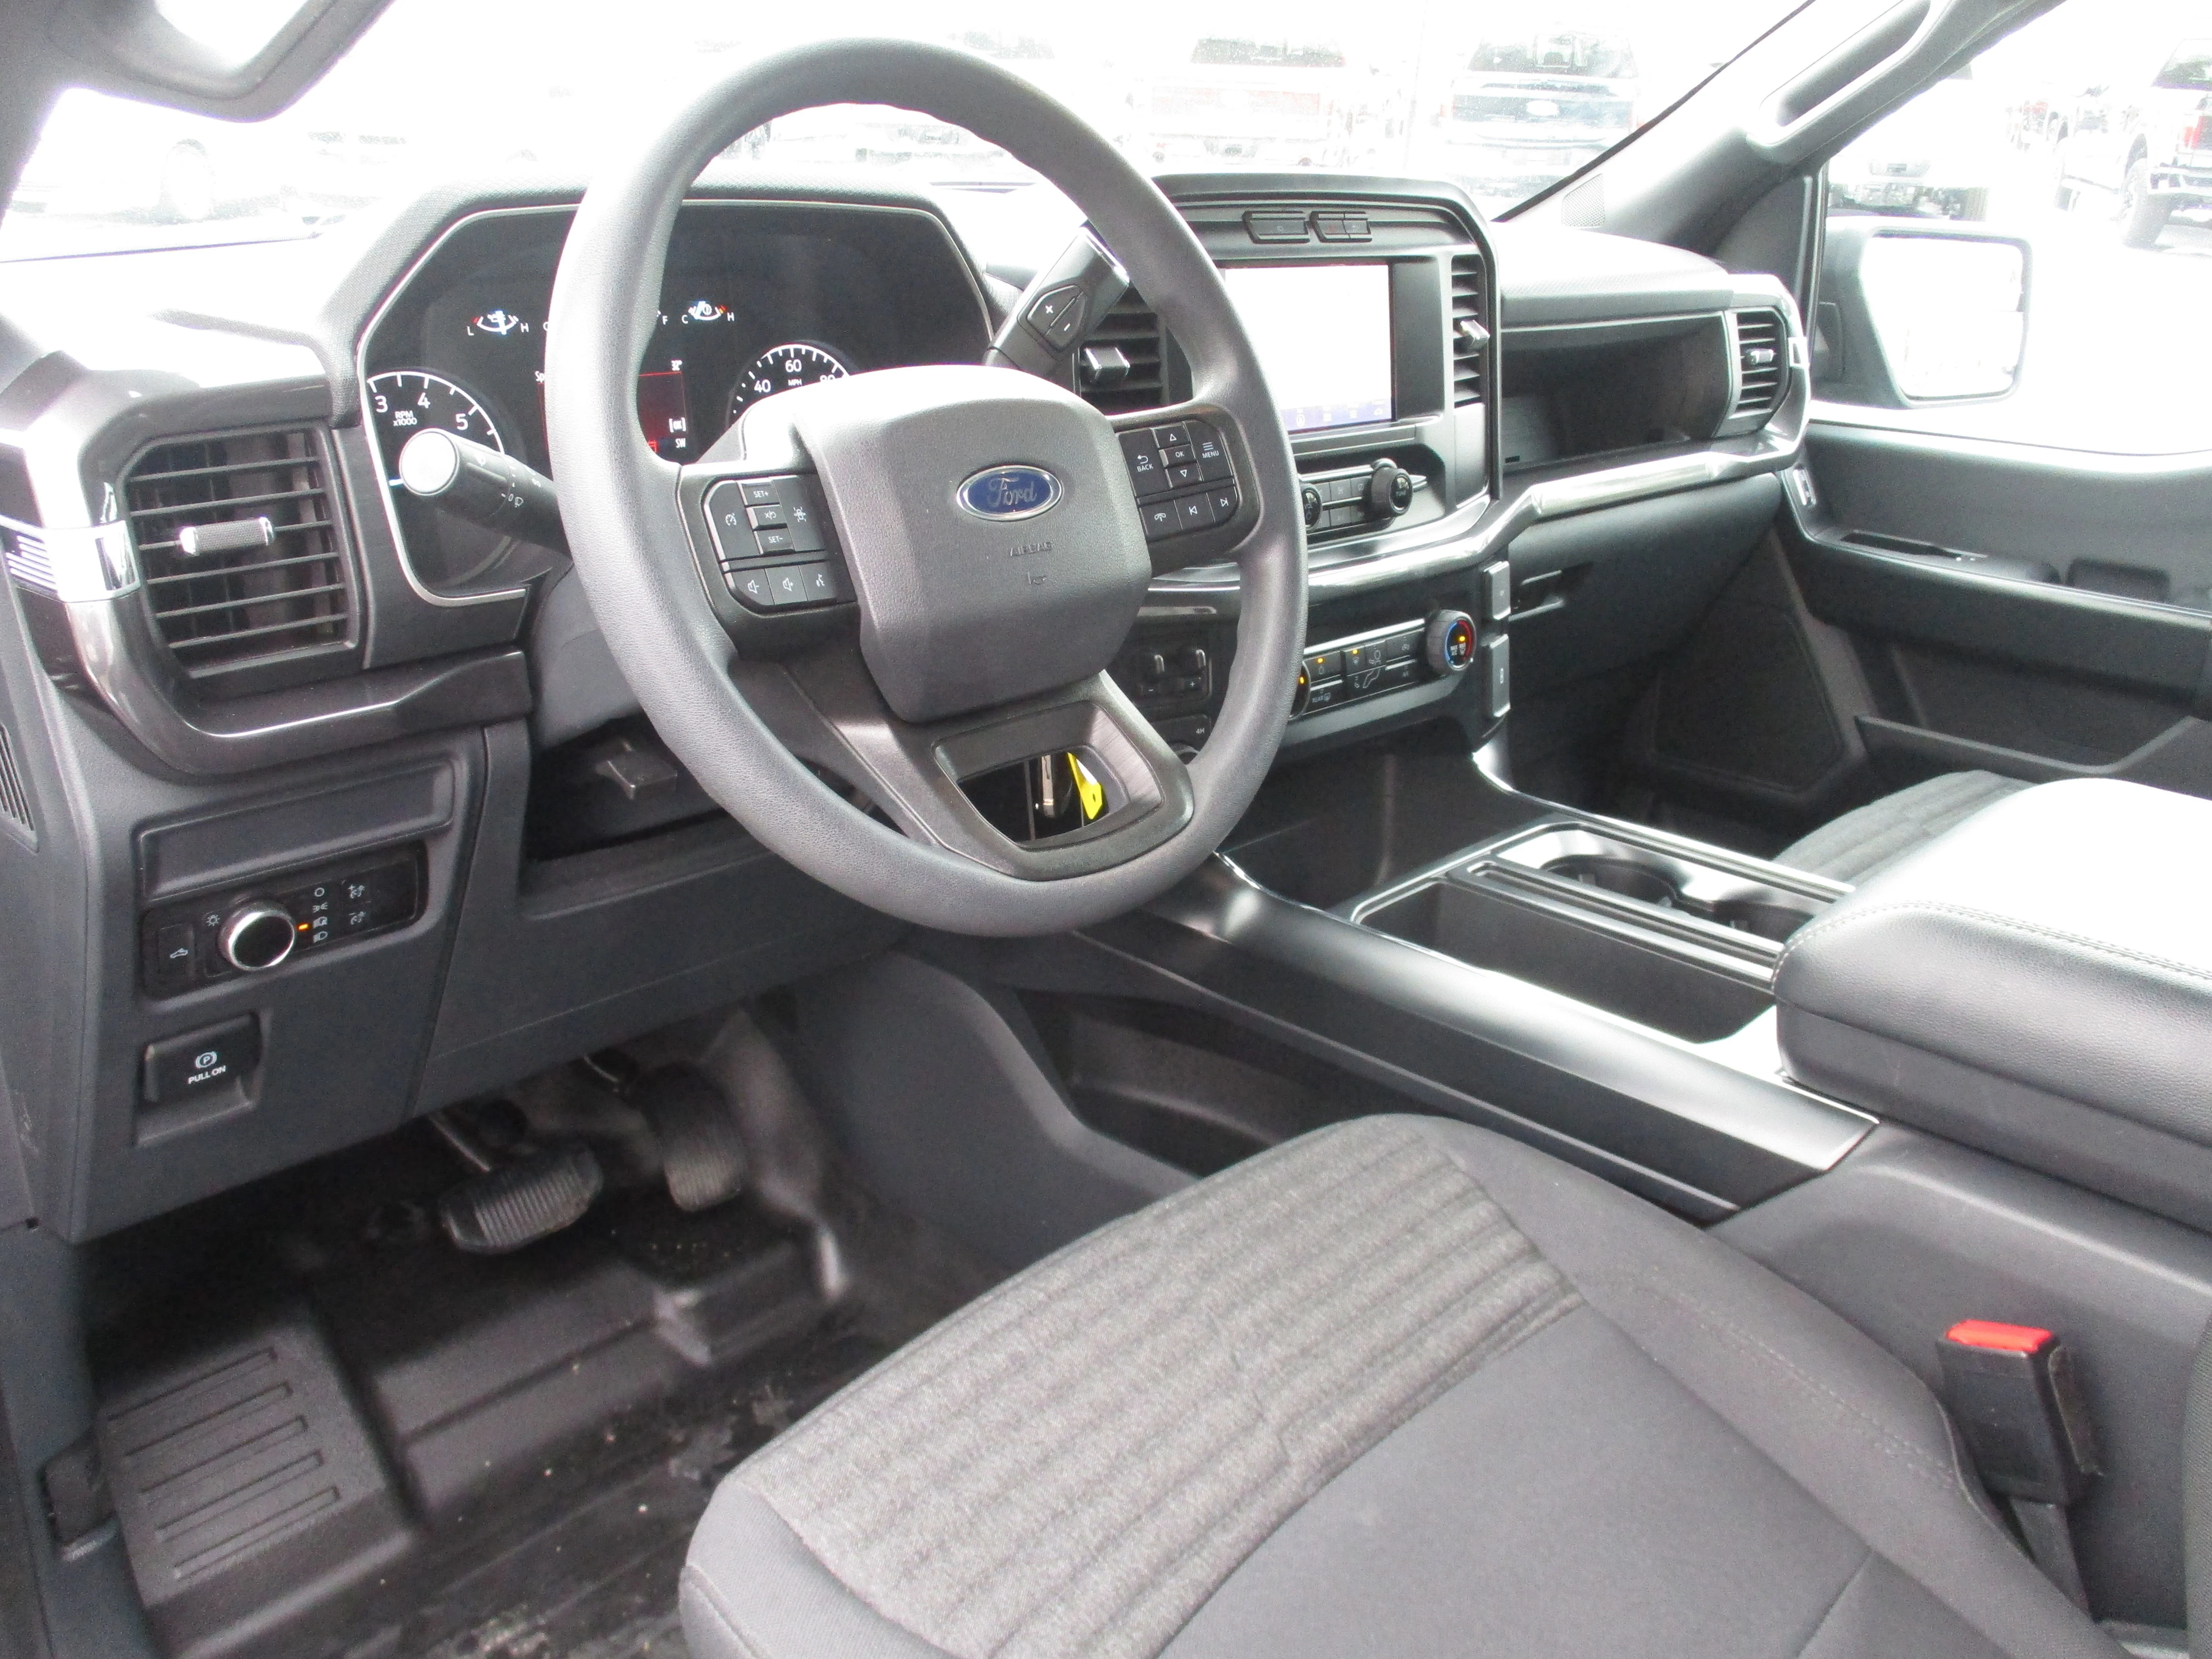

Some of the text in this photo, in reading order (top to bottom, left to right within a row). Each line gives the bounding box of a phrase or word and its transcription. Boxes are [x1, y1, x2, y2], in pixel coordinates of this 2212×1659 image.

[662, 315, 668, 325] F
[682, 315, 688, 324] C
[727, 312, 735, 322] H
[467, 326, 474, 336] L
[521, 323, 529, 333] H
[785, 359, 802, 372] 60
[754, 379, 771, 392] 40
[375, 395, 388, 413] 3
[417, 392, 431, 408] 4
[395, 410, 414, 419] RPM
[393, 417, 418, 426] x1000
[456, 413, 468, 430] 5
[675, 438, 686, 448] SW
[1202, 450, 1219, 459] MENU
[1137, 463, 1154, 472] BACK
[988, 477, 1037, 507] Ford
[188, 1065, 226, 1085] PULL ON
